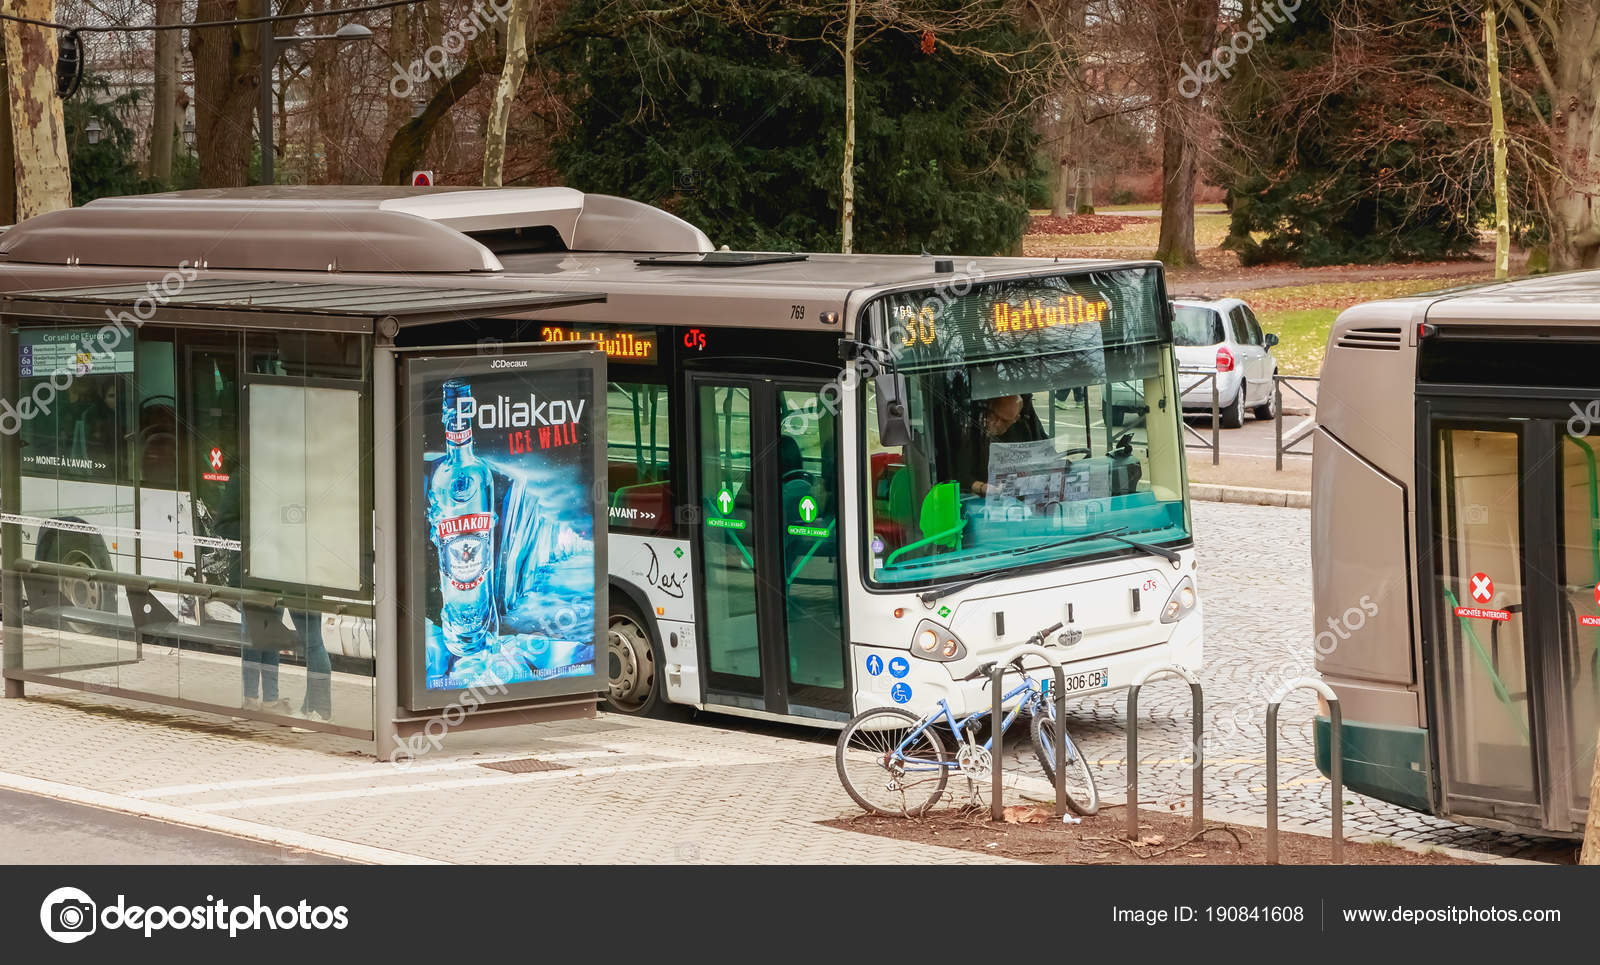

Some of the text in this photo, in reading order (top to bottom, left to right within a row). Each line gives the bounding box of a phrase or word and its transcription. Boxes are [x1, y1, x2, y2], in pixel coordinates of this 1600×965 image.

[790, 304, 806, 321] 769
[893, 305, 912, 319] 769
[994, 295, 1108, 333] Wattwiller
[901, 306, 936, 346] 30
[23, 346, 29, 354] 6
[570, 331, 652, 358] twiller
[21, 358, 31, 366] 6a
[490, 359, 528, 369] JCDecaux
[21, 367, 32, 375] 6b
[456, 394, 586, 430] Poliakov
[508, 422, 579, 455] ICE WALL
[440, 516, 489, 535] POLIAKOV
[1482, 610, 1509, 619] INTERDITE
